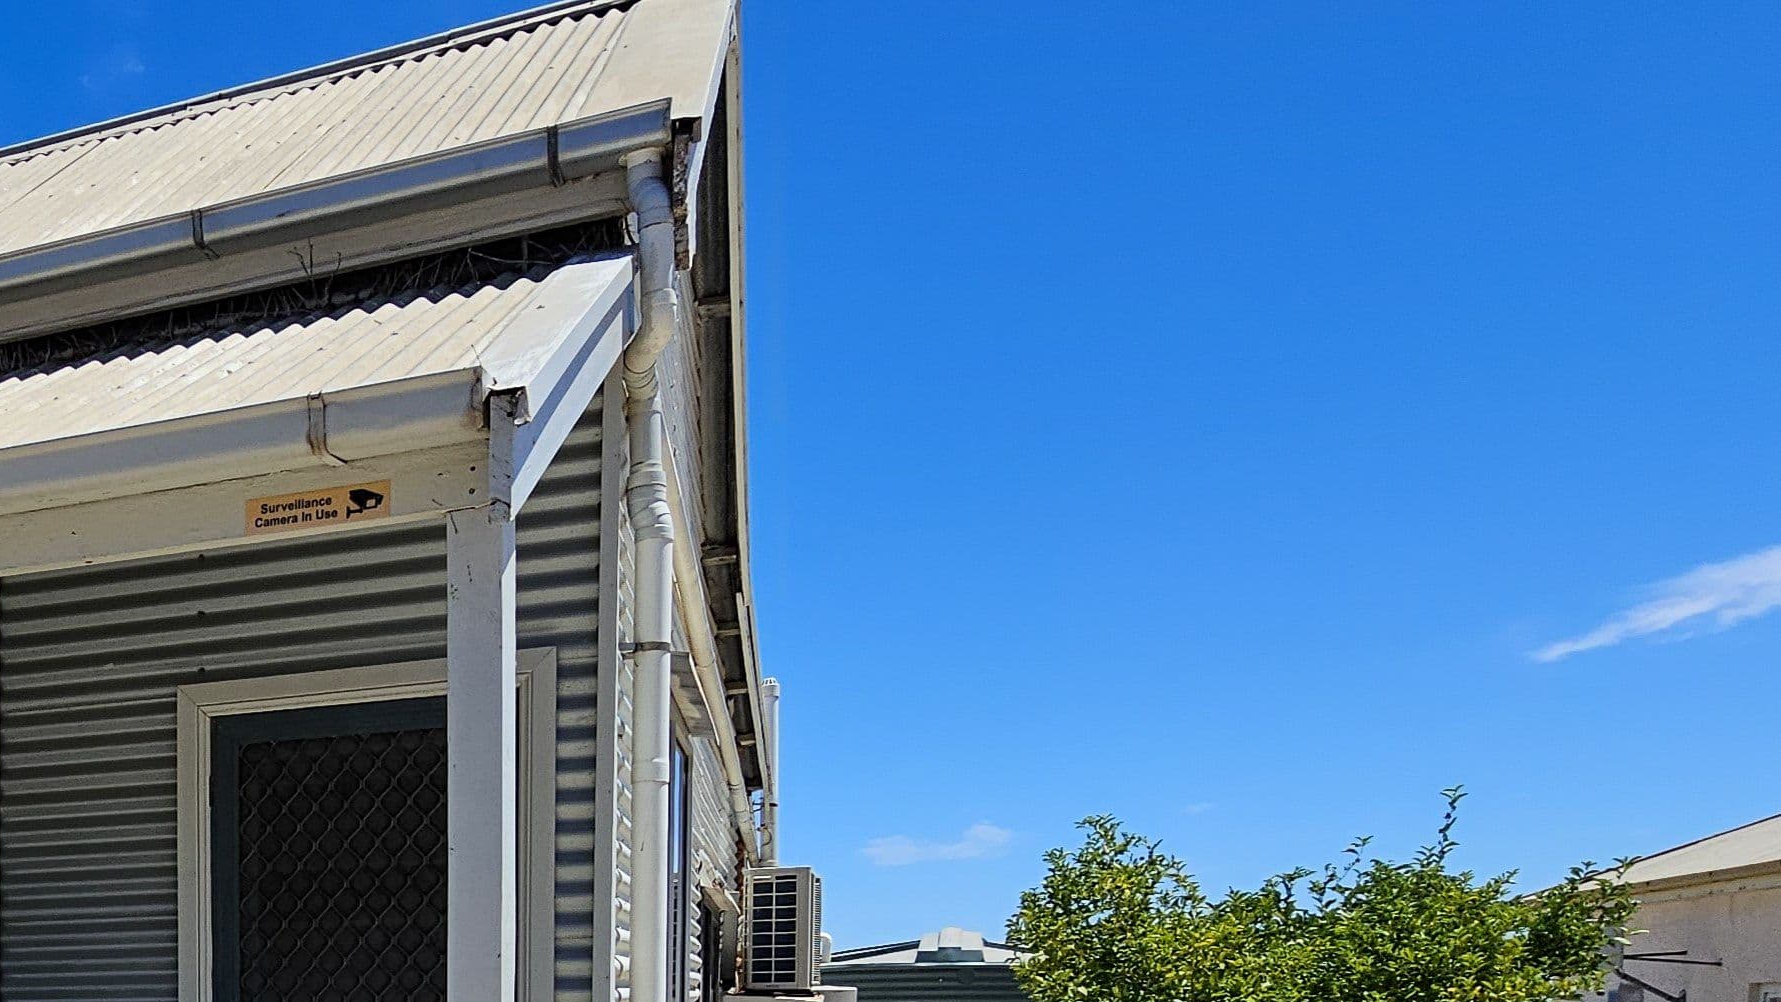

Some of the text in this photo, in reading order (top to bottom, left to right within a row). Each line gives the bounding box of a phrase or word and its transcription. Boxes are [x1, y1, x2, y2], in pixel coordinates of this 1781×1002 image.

[260, 497, 332, 514] Surveillance
[255, 509, 338, 528] Camera In Use
